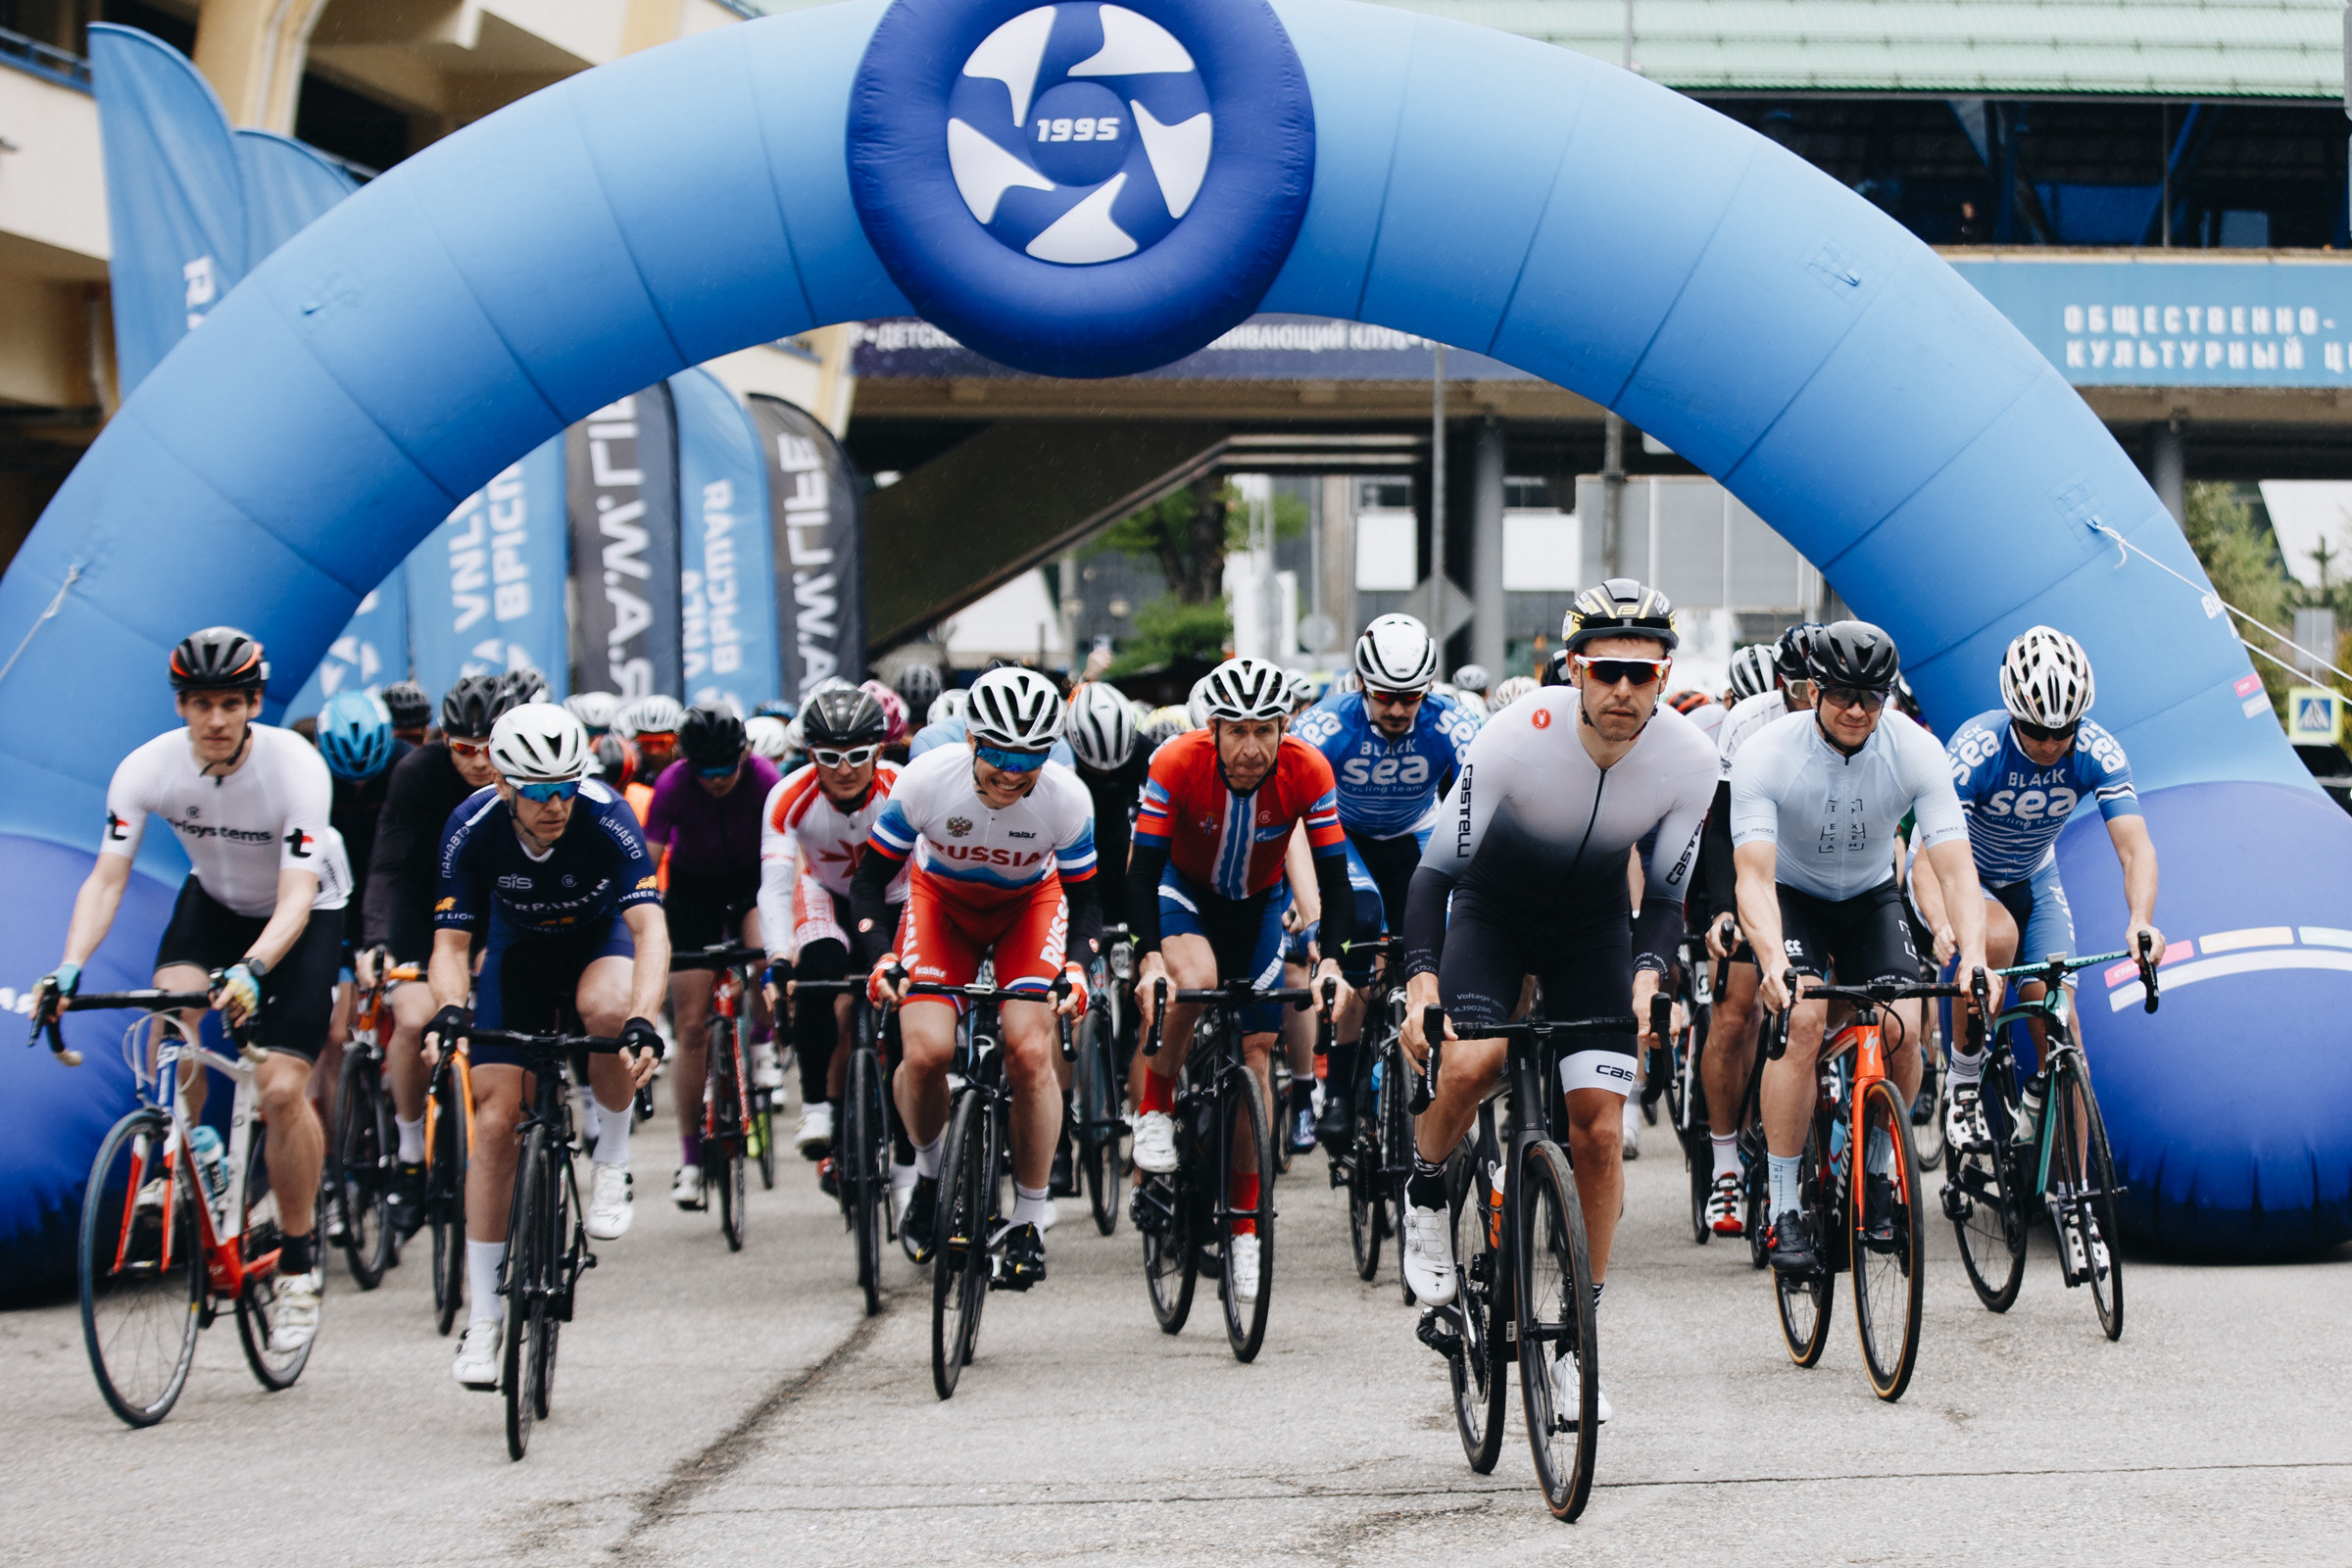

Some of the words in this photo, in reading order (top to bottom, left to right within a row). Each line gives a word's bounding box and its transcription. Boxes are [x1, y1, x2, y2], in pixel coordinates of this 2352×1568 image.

[1037, 118, 1120, 142] 1995
[2064, 305, 2337, 337] ОБЩЕСТВЕННО-
[2066, 336, 2304, 369] КУЛЬТУРНЫЙ
[2325, 341, 2352, 374] Ц
[1341, 756, 1429, 785] sea
[1982, 787, 2078, 819] sea
[929, 839, 1042, 867] RUSSIA
[1456, 993, 1492, 1003] Voltage
